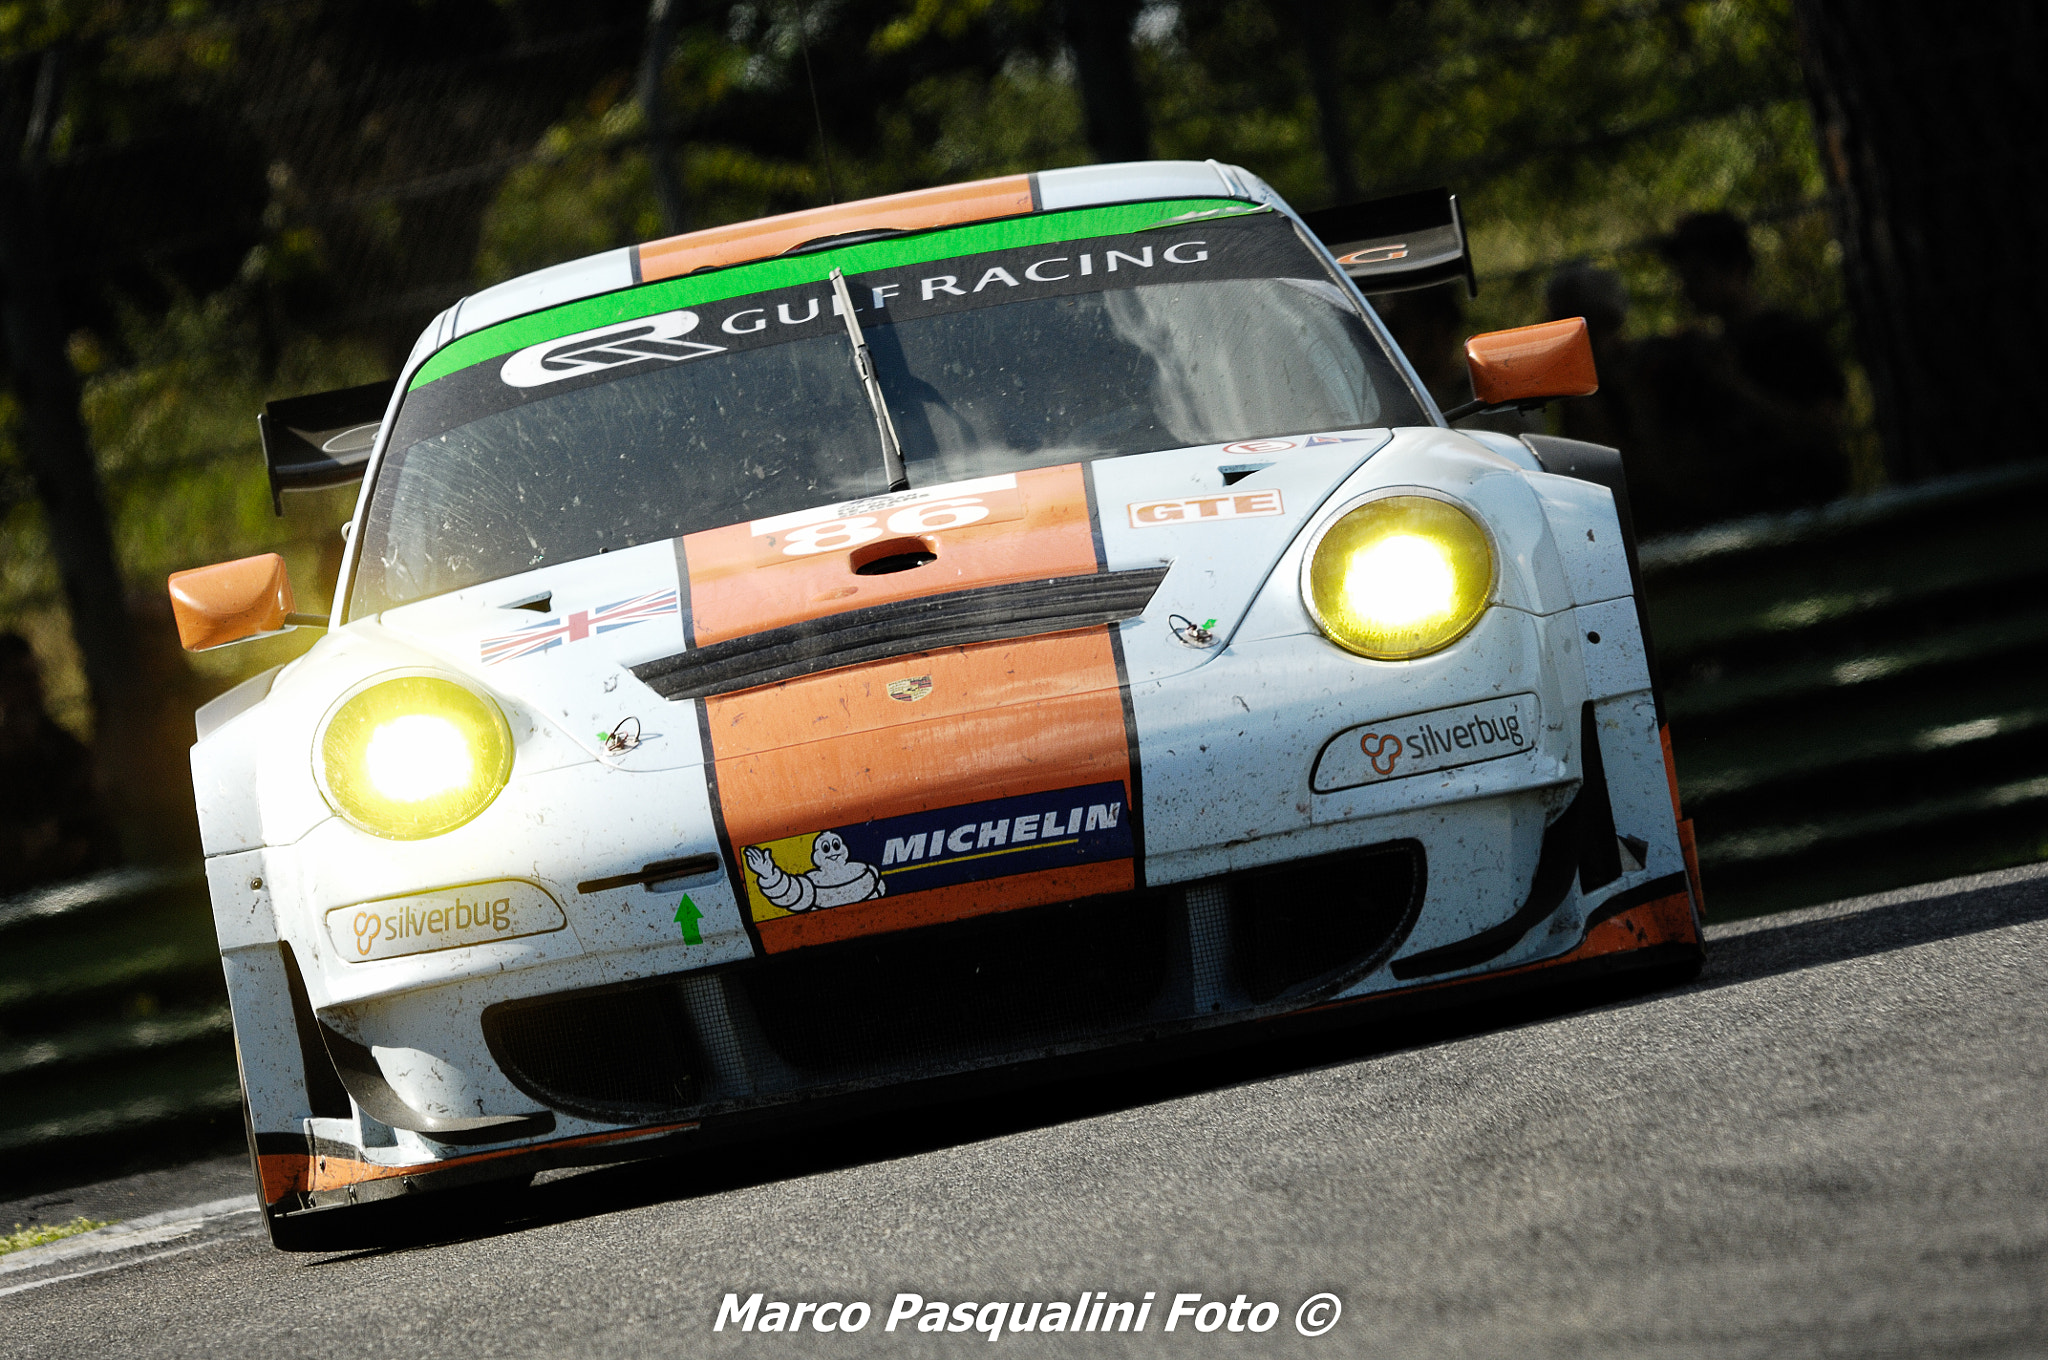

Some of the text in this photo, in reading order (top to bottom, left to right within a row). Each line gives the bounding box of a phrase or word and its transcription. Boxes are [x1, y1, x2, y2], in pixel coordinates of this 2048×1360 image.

[721, 283, 900, 335] GULF
[920, 240, 1209, 301] RACING
[782, 497, 990, 556] 86
[1136, 493, 1277, 523] GTE
[1405, 714, 1522, 760] silverbug
[881, 801, 1121, 866] MICHELIN
[384, 896, 511, 942] silverbug
